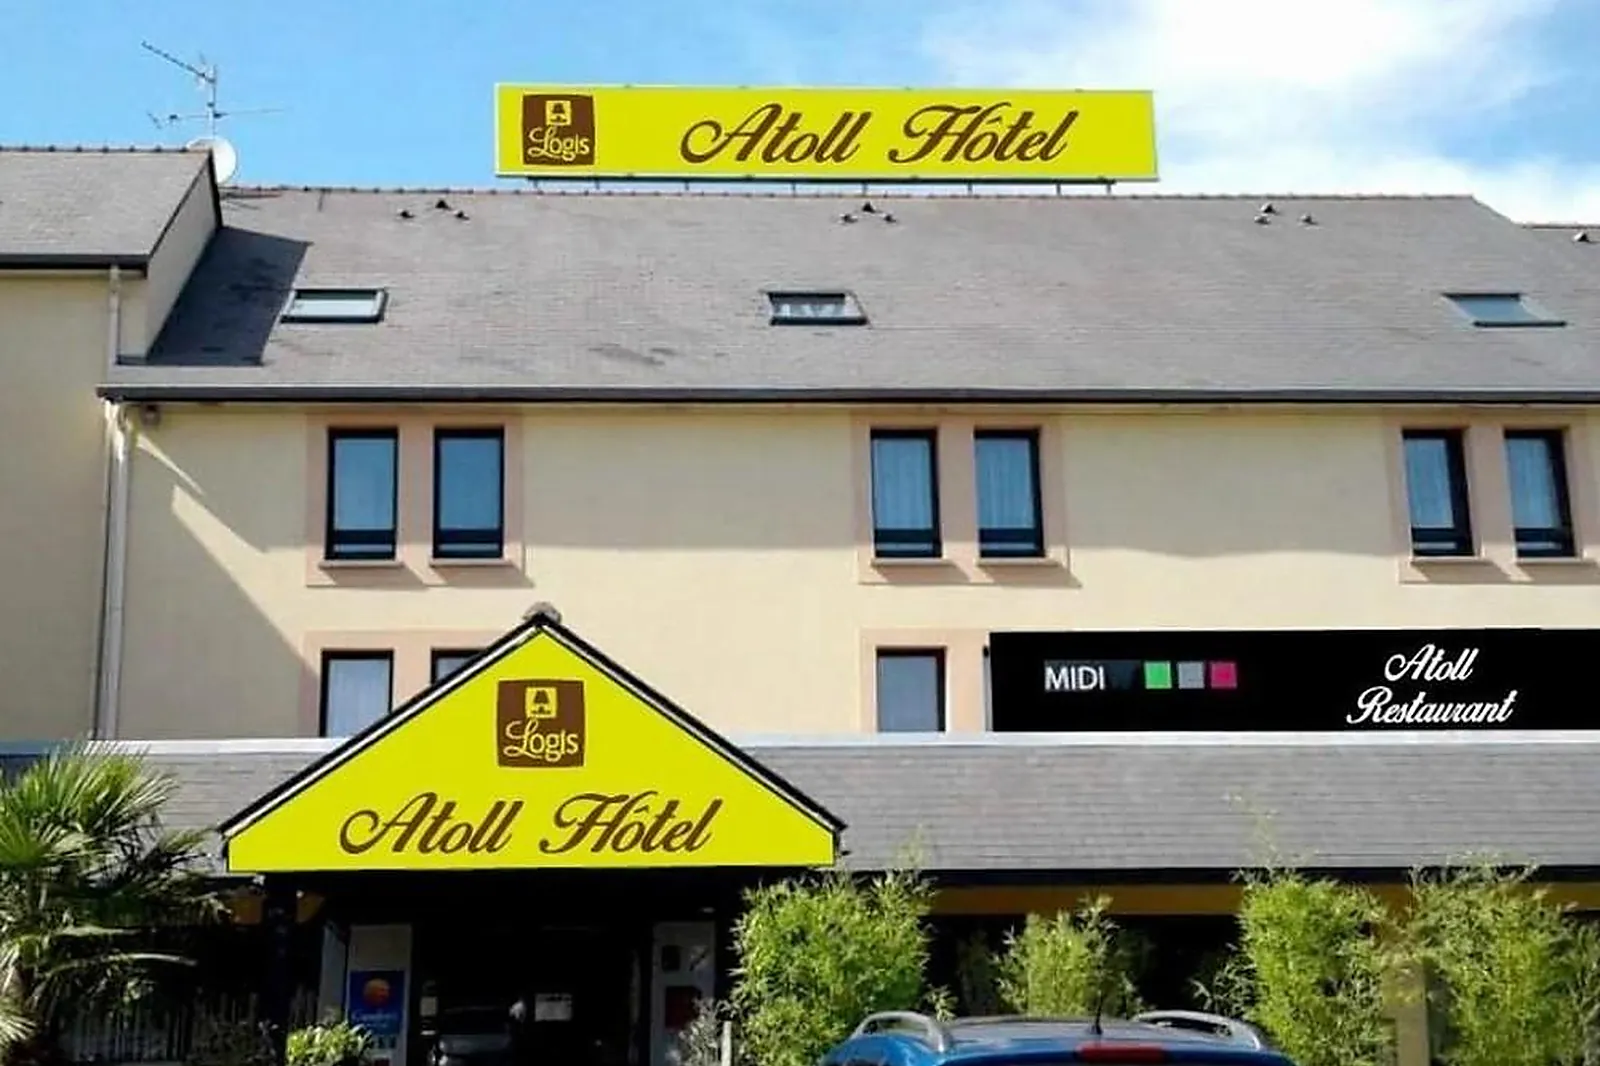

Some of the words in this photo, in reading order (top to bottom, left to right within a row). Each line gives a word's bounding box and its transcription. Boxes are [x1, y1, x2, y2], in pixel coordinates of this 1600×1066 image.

[527, 126, 590, 161] Logis
[681, 104, 871, 163] Atoll
[888, 102, 1078, 163] Hôtel
[1045, 665, 1104, 690] MIDI
[1385, 644, 1478, 681] Atoll
[1347, 685, 1517, 723] Restaurant
[505, 719, 578, 762] Logis
[340, 792, 523, 854] Atoll
[539, 791, 722, 853] Hôtel
